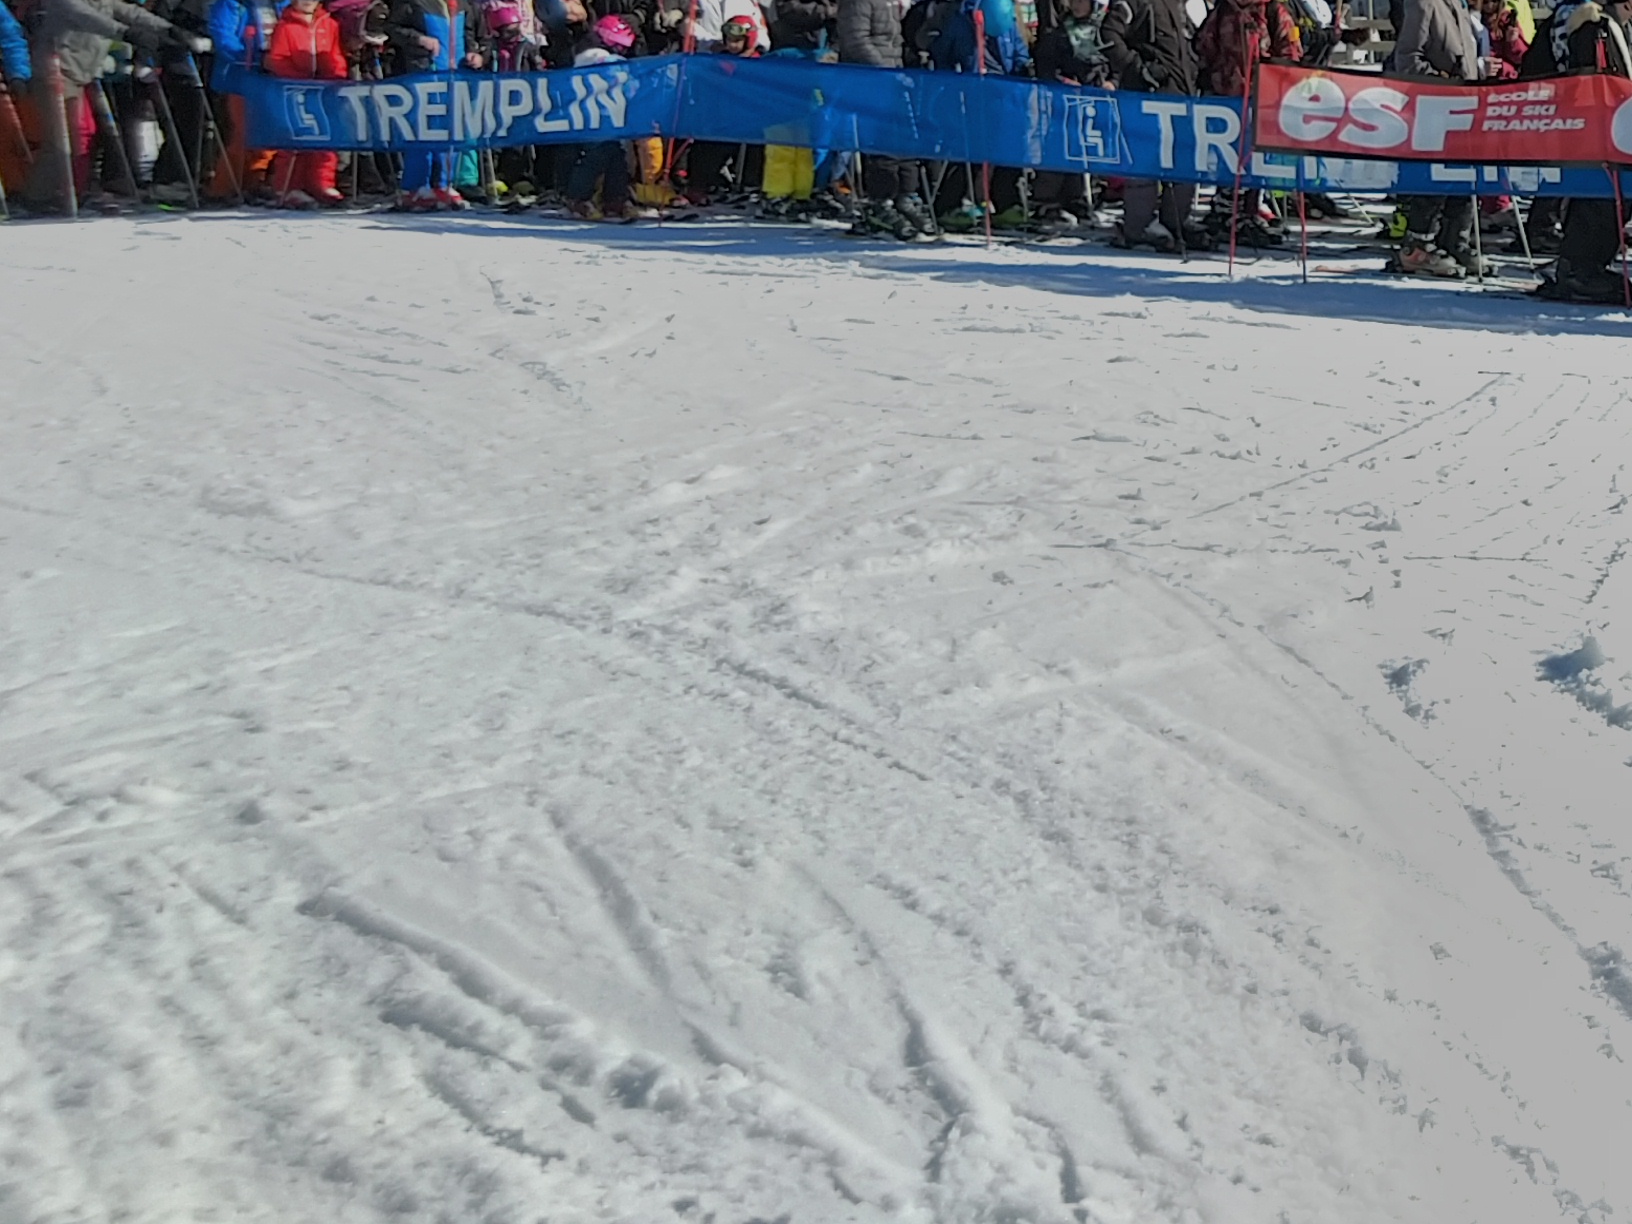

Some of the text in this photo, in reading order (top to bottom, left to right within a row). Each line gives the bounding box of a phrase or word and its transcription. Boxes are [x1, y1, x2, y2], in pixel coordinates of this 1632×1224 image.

[338, 73, 627, 142] TREMPLIN
[1486, 104, 1557, 117] DU SKI
[1482, 118, 1586, 133] FRANÇAIS
